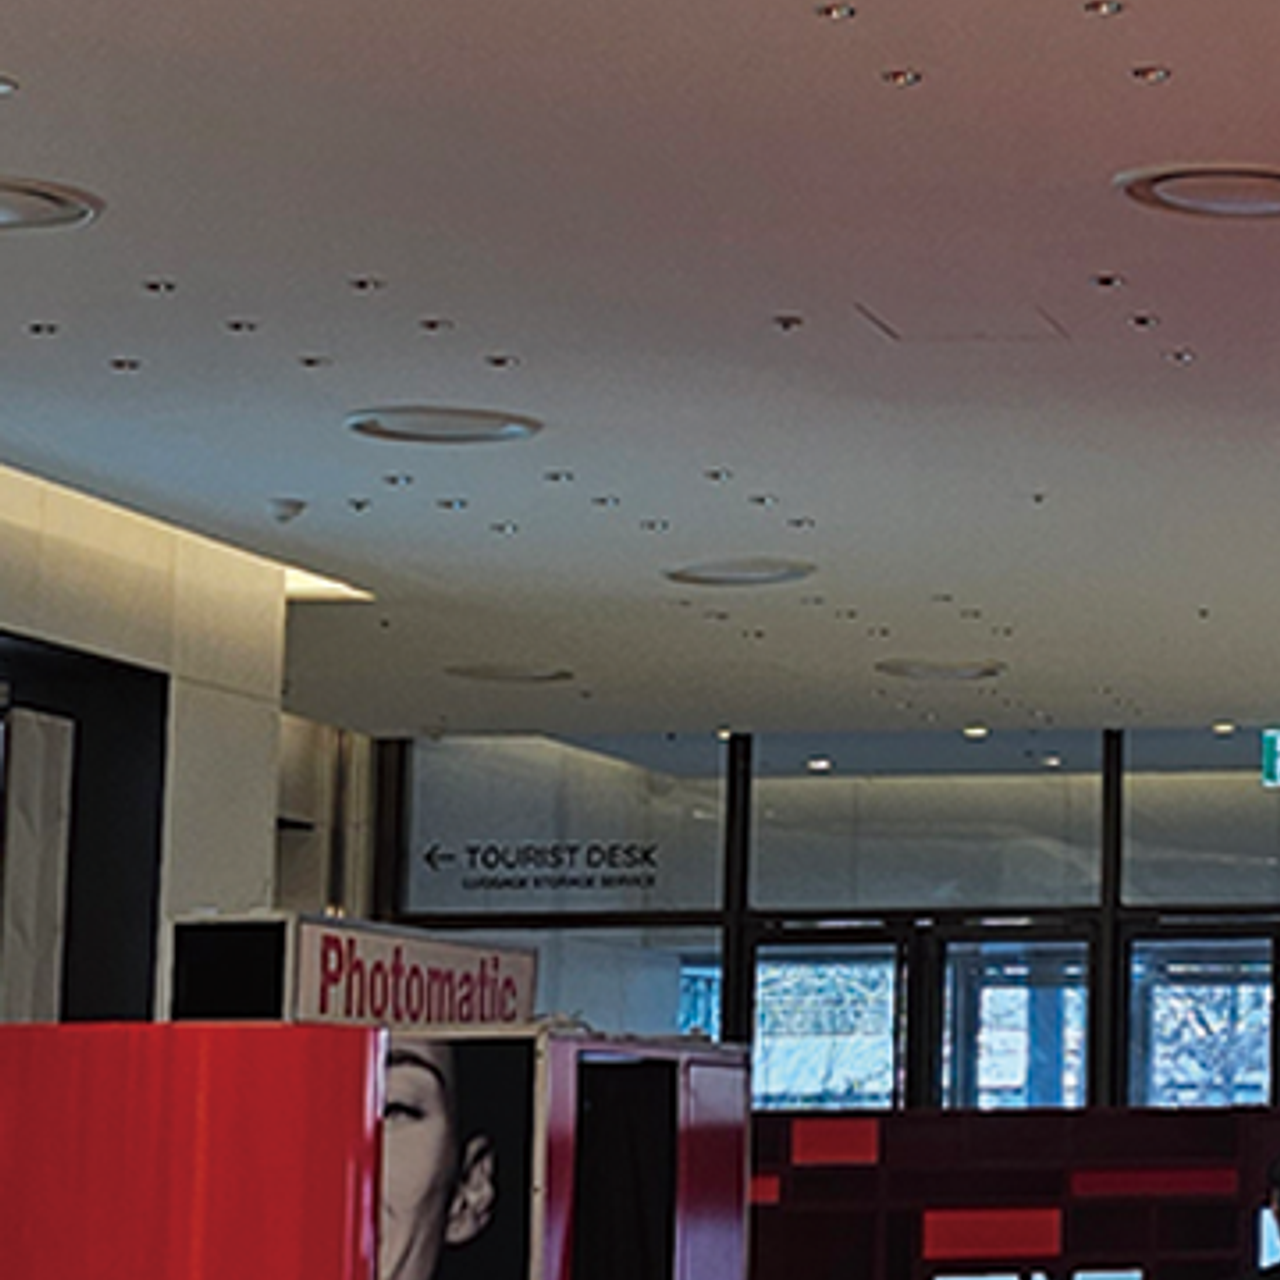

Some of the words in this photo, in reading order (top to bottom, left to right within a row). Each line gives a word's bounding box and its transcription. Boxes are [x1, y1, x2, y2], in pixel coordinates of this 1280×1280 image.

[466, 843, 581, 869] TOURIST
[586, 843, 657, 869] DESK
[319, 934, 517, 1022] Photomatic
